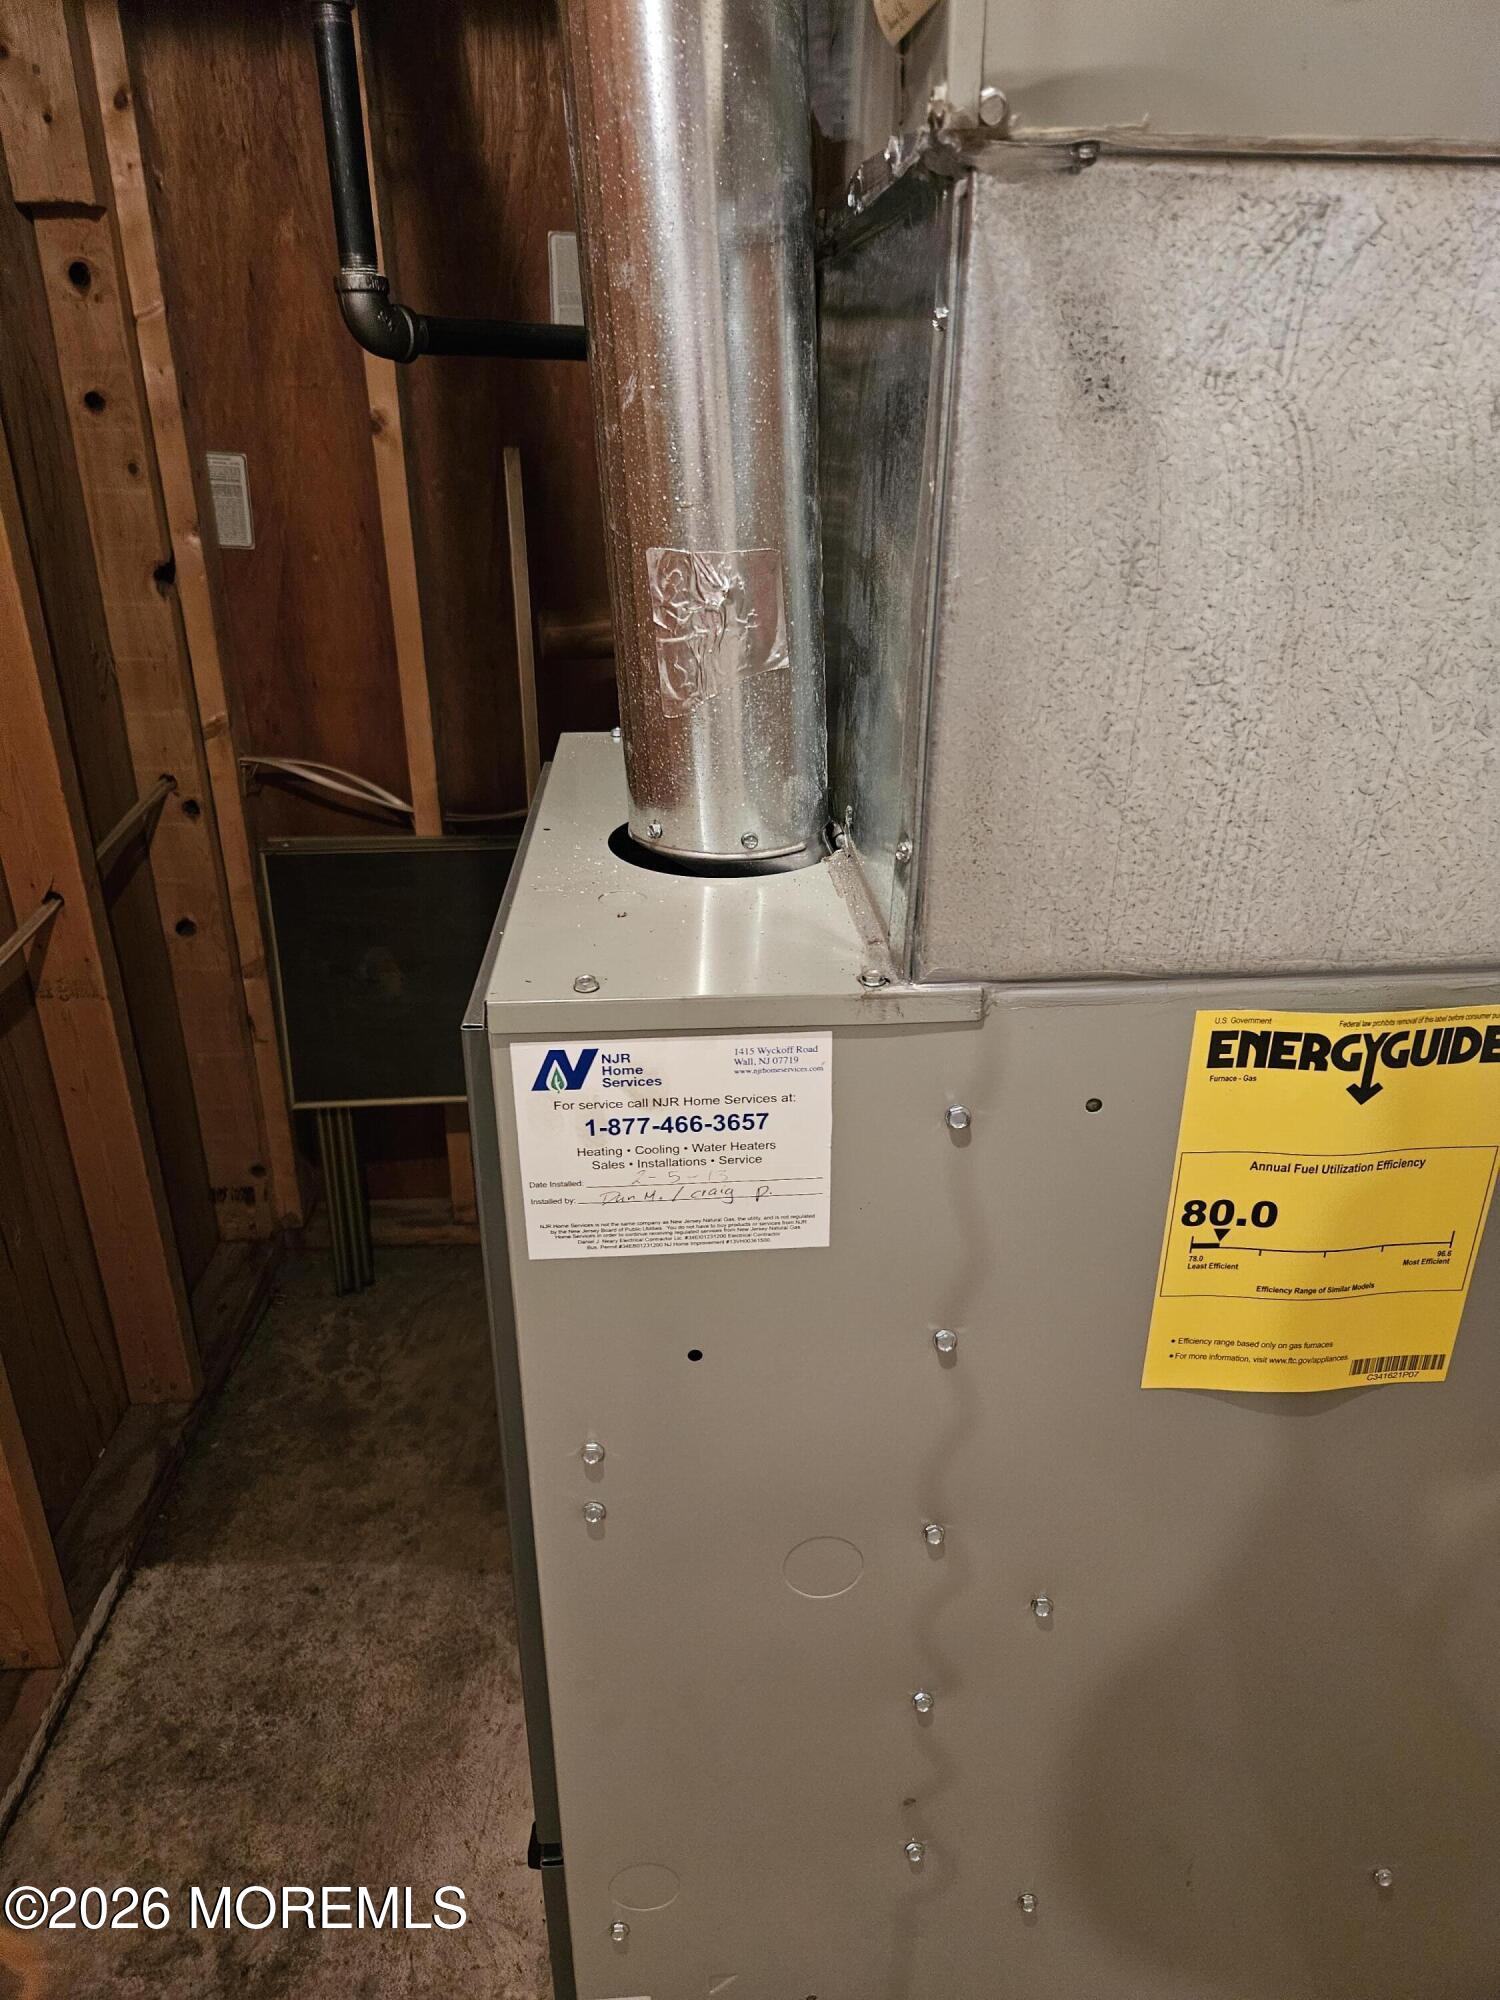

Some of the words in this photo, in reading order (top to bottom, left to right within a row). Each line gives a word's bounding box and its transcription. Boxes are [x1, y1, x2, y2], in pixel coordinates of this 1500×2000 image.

[1231, 1017, 1272, 1025] Government
[734, 1047, 754, 1056] 1415
[757, 1046, 793, 1057] Wyckoff
[796, 1045, 819, 1054] Road
[1207, 1025, 1500, 1088] ENERGYGUIDE
[601, 1053, 631, 1064] NJR
[734, 1058, 756, 1067] Wall,
[758, 1057, 771, 1065] NJ
[773, 1056, 799, 1065] 07719
[602, 1066, 643, 1076] Home
[602, 1077, 662, 1088] Services
[553, 1101, 574, 1111] For
[579, 1101, 623, 1110] service
[628, 1098, 648, 1108] call
[653, 1097, 679, 1107] NJR
[684, 1096, 720, 1106] Home
[725, 1094, 777, 1105] Services
[781, 1093, 796, 1103] at:
[585, 1113, 769, 1136] 1-877-466-3657
[577, 1147, 623, 1158] Heating
[635, 1145, 680, 1156] Cooling
[692, 1143, 727, 1153] Water
[730, 1141, 776, 1151] Heaters
[592, 1160, 625, 1170] Sales
[637, 1158, 707, 1169] Installations
[719, 1155, 762, 1165] Service
[1250, 1160, 1291, 1173] Annual
[1294, 1163, 1318, 1174] Fuel
[1322, 1162, 1373, 1174] Utilization
[1376, 1158, 1426, 1171] Efficiency
[529, 1181, 547, 1189] Date
[530, 1197, 563, 1205] Installed
[564, 1197, 576, 1206] by:
[1181, 1199, 1278, 1228] 80.0
[1256, 1285, 1293, 1295] Efficiency
[1294, 1287, 1318, 1295] Range
[1319, 1286, 1327, 1294] of
[1327, 1285, 1350, 1294] Similar
[1351, 1282, 1375, 1292] Models
[1178, 1337, 1212, 1346] Efficiency
[1214, 1339, 1235, 1348] range
[1237, 1339, 1259, 1348] based
[1261, 1341, 1276, 1350] only
[1304, 1341, 1333, 1349] furnaces
[1175, 1352, 1187, 1360] For
